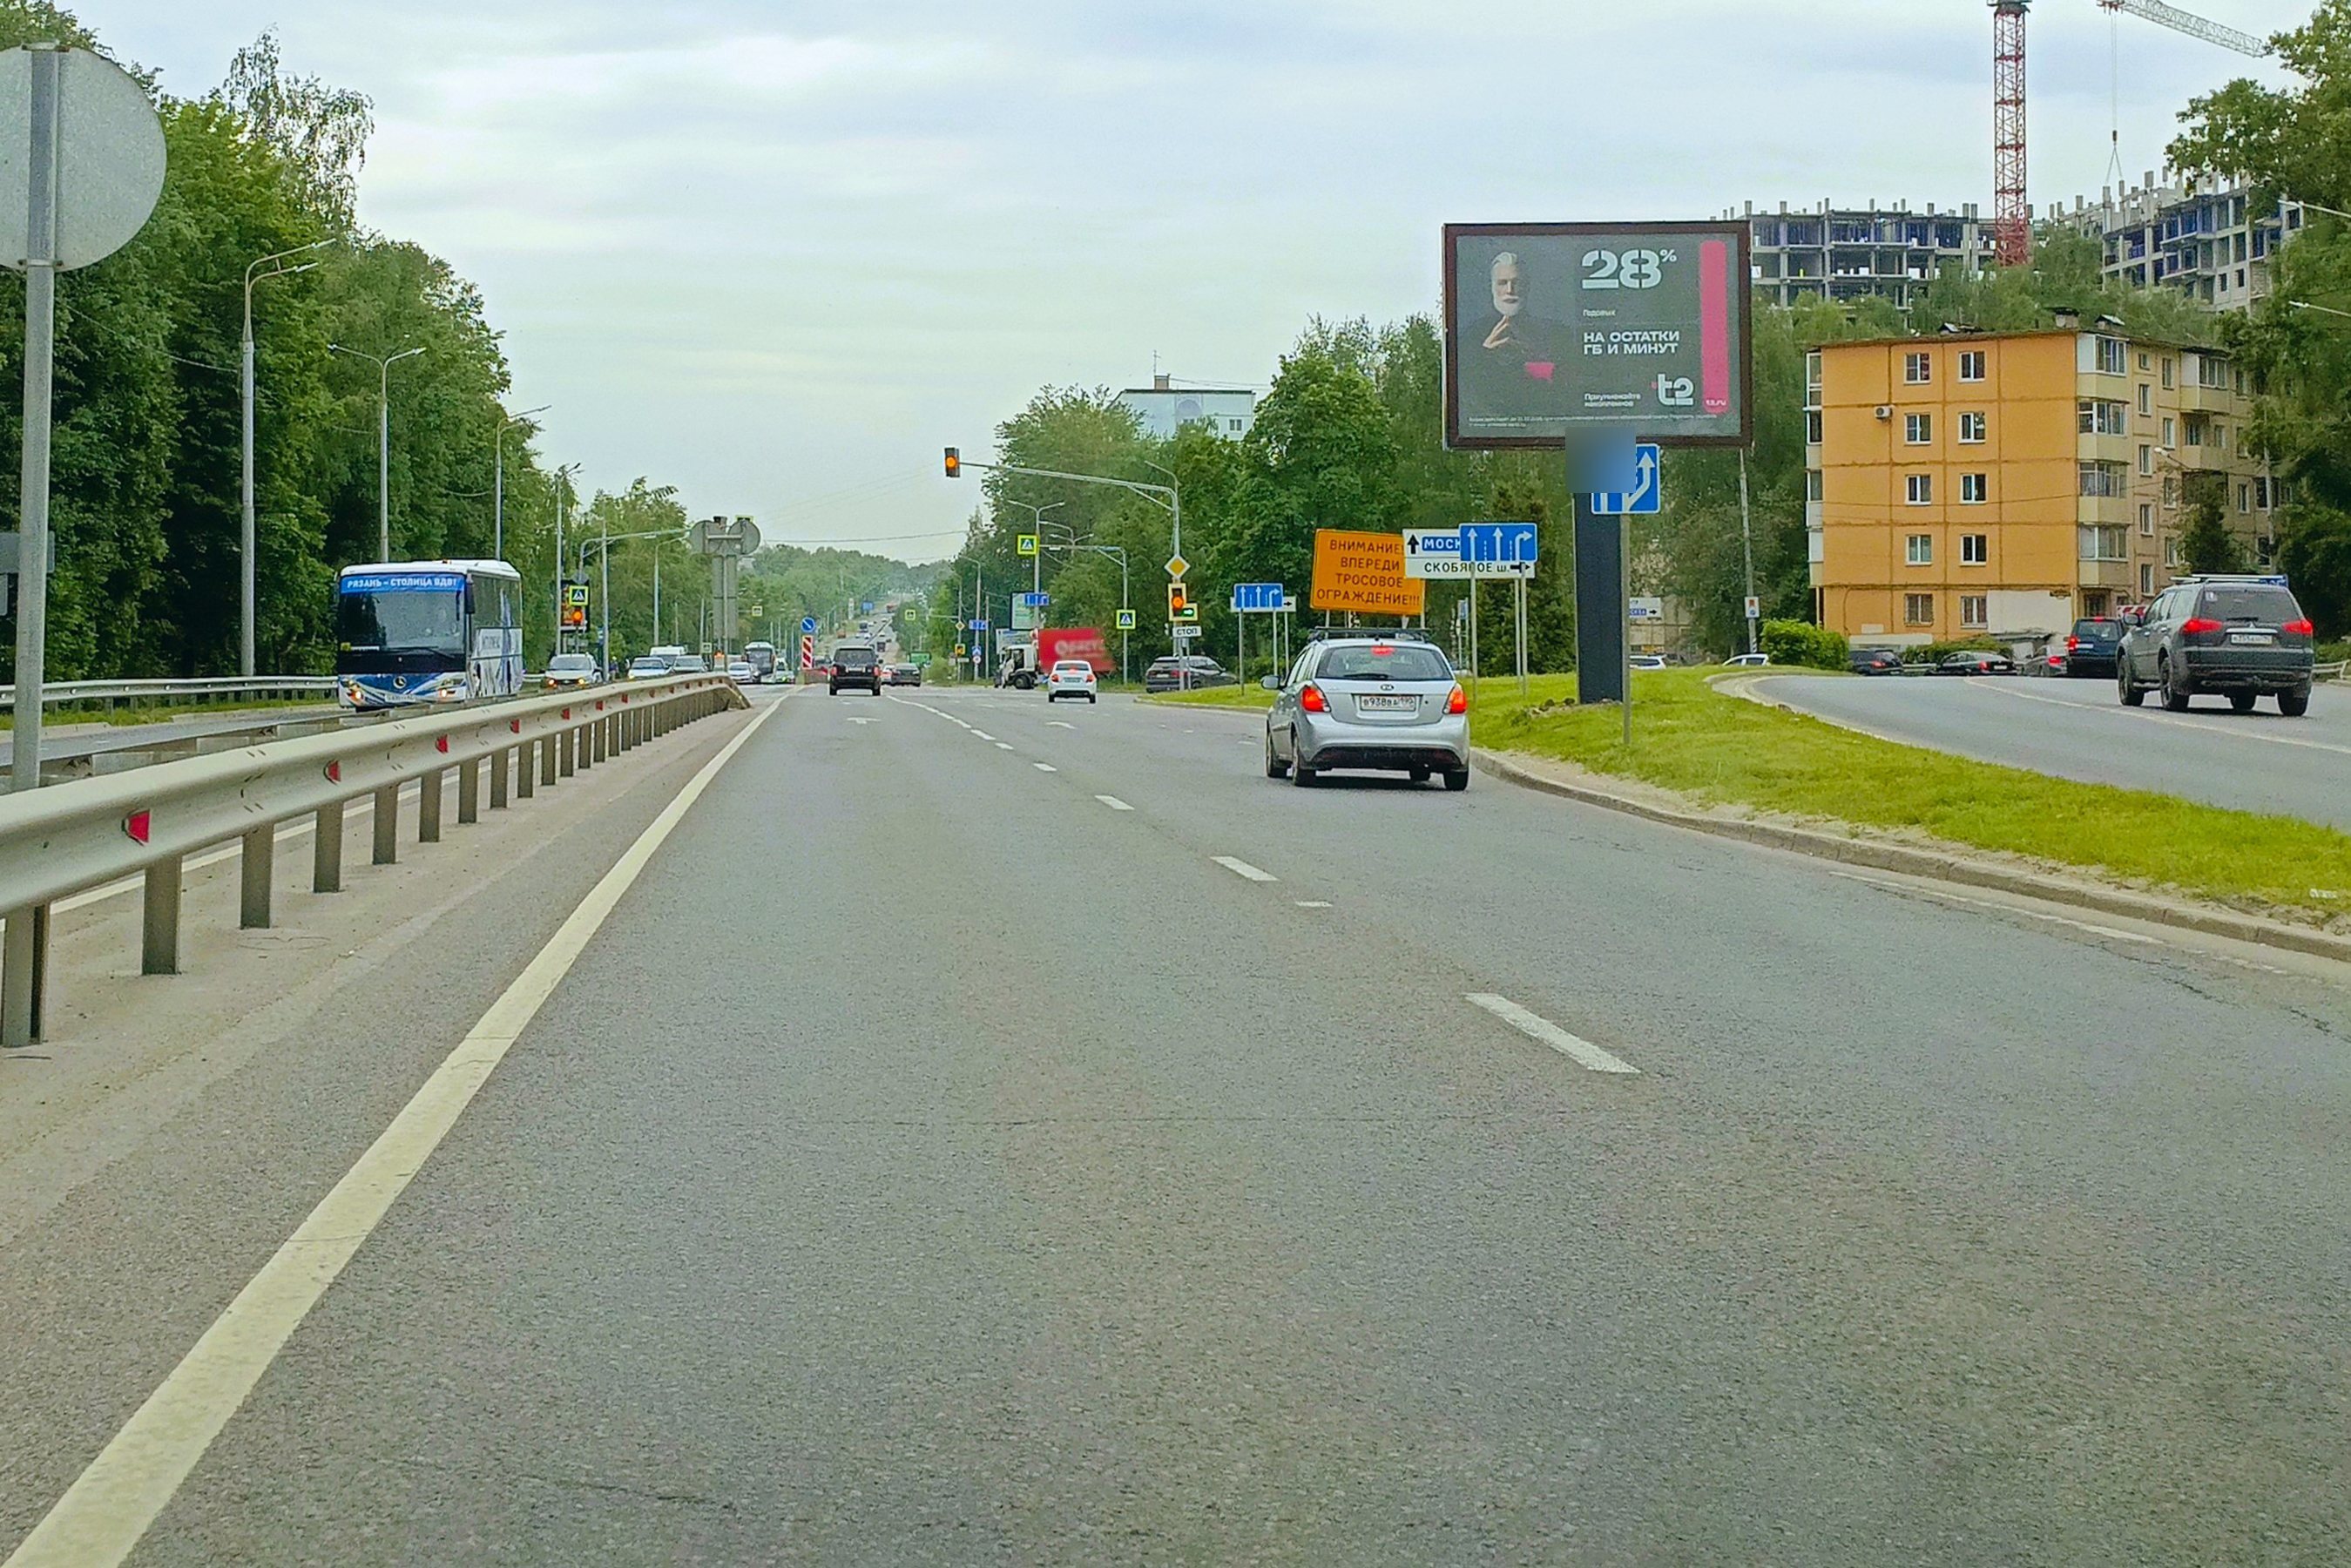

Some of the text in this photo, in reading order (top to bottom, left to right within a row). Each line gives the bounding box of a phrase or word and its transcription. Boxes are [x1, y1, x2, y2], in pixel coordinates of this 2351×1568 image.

[1584, 330, 1679, 343] НА ОСТАТКИ
[1584, 343, 1679, 355] ГБ И МИНУТ
[1658, 373, 1694, 406] t2
[1423, 537, 1461, 550] МОСК
[1341, 557, 1400, 572] ВПЕРЕДИ
[347, 579, 382, 588] РЯЗАНЬ
[390, 578, 433, 587] СТОЛИЦА
[1335, 572, 1403, 588] ТРОСОВОЕ
[1316, 588, 1421, 606] ОГРАЖДЕНИЕ!!!
